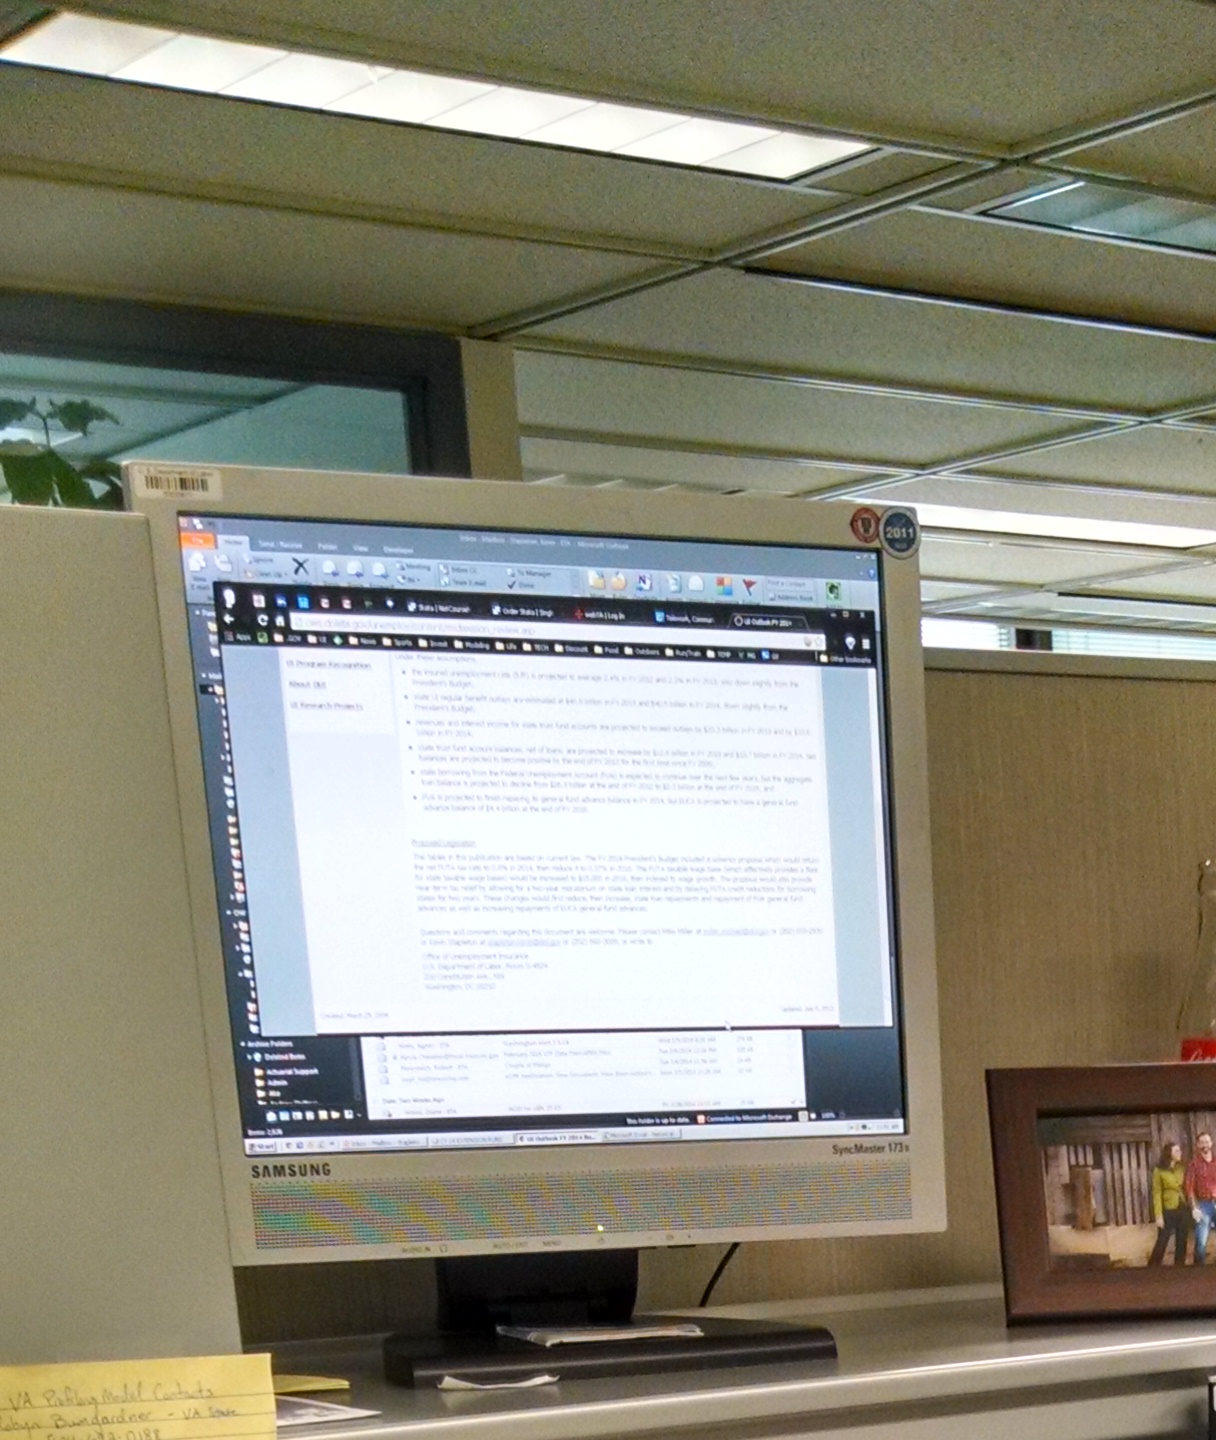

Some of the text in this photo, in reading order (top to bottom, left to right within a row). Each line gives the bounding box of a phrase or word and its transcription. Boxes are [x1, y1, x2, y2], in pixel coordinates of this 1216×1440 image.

[886, 527, 915, 539] 2011
[832, 1143, 886, 1155] SyncMaster
[251, 1162, 332, 1179] SAMSUNG
